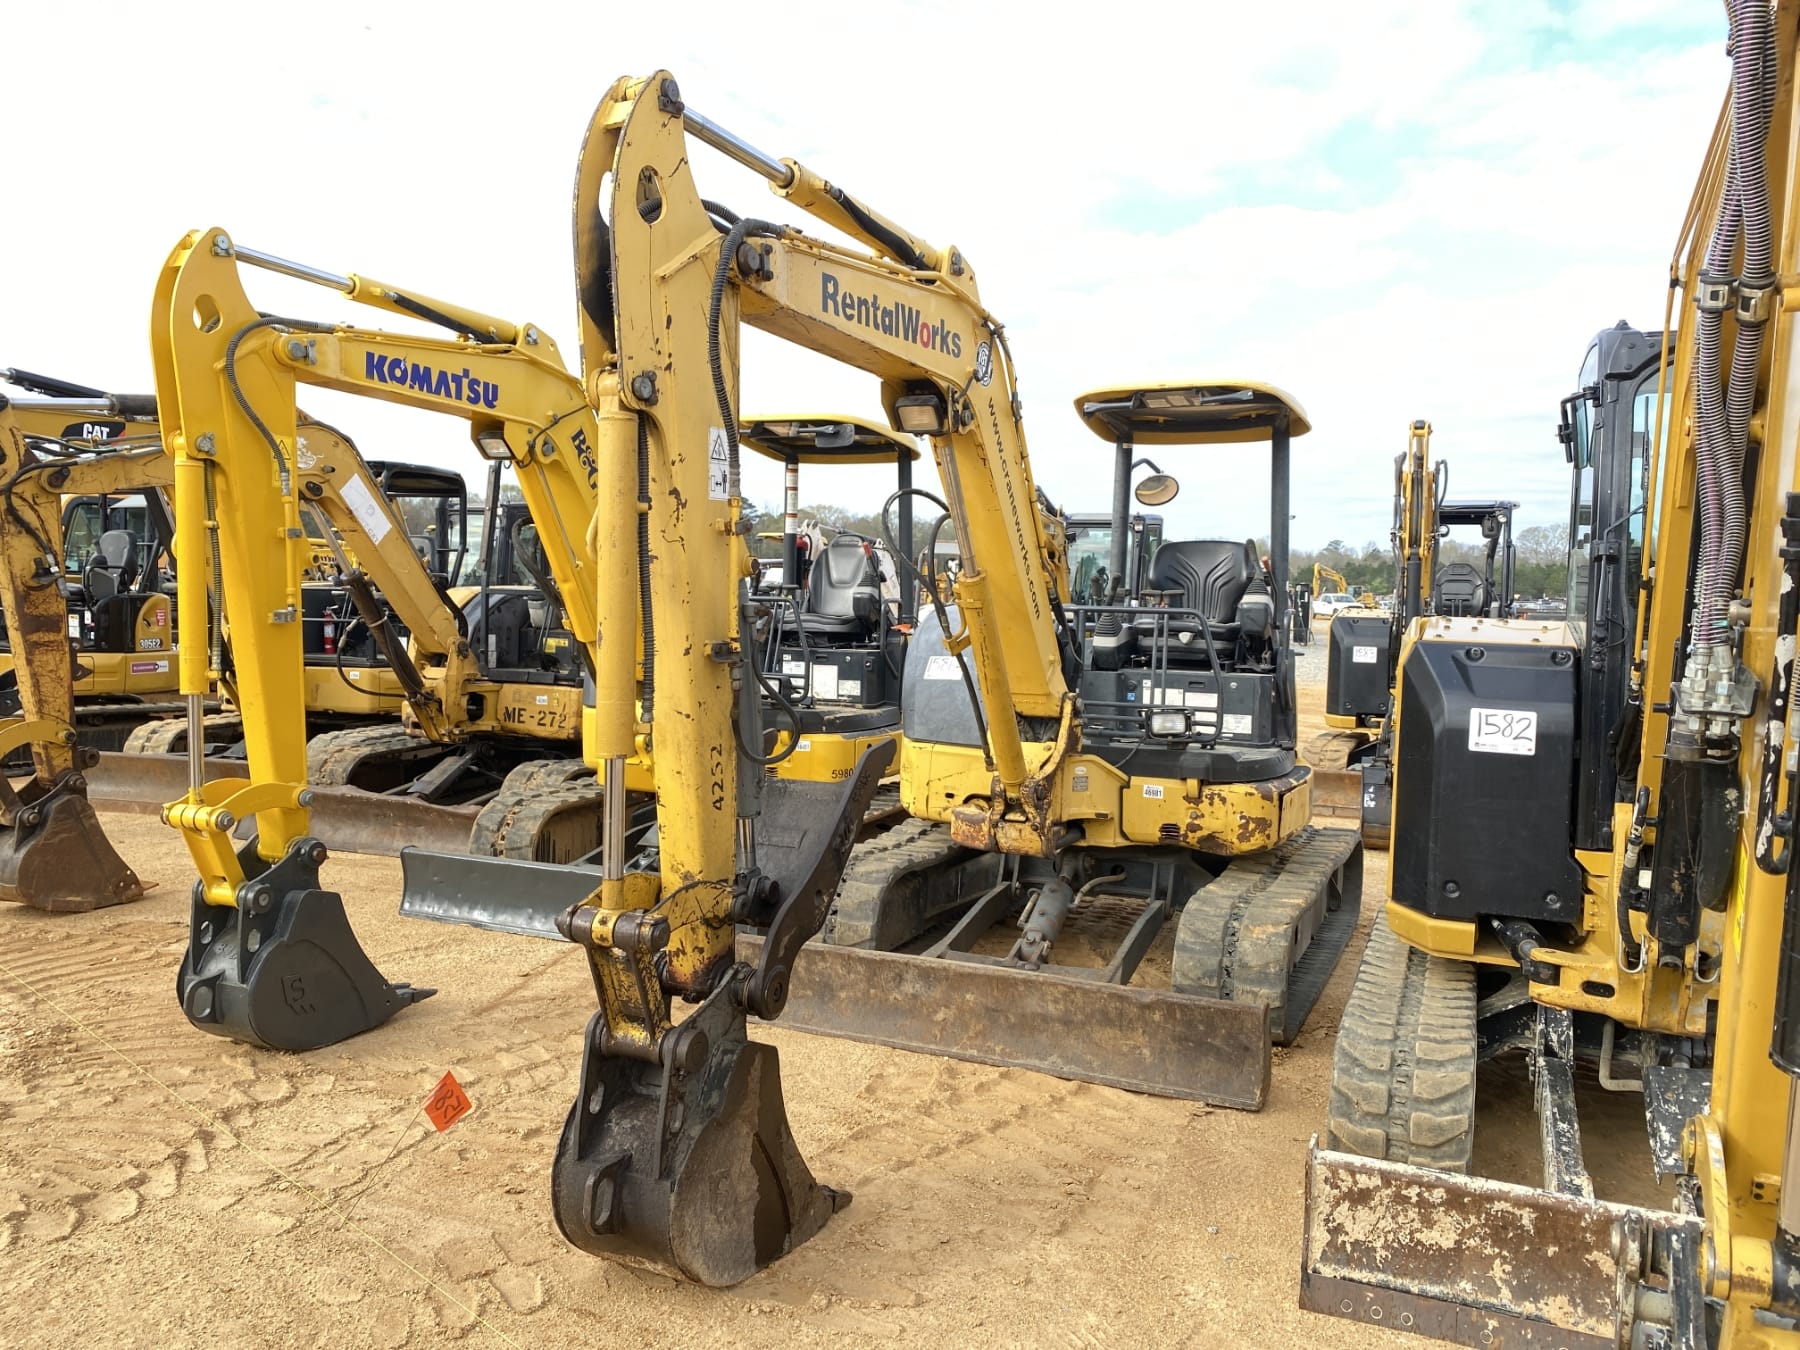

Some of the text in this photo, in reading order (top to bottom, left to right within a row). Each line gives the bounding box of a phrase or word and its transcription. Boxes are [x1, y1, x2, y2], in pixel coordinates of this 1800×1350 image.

[821, 271, 962, 360] RentalWorks
[365, 351, 499, 409] KOMATSU
[82, 423, 110, 440] CAT
[987, 397, 1041, 621] www.craneworks.com
[1477, 711, 1533, 742] 1582
[711, 744, 725, 811] 4252
